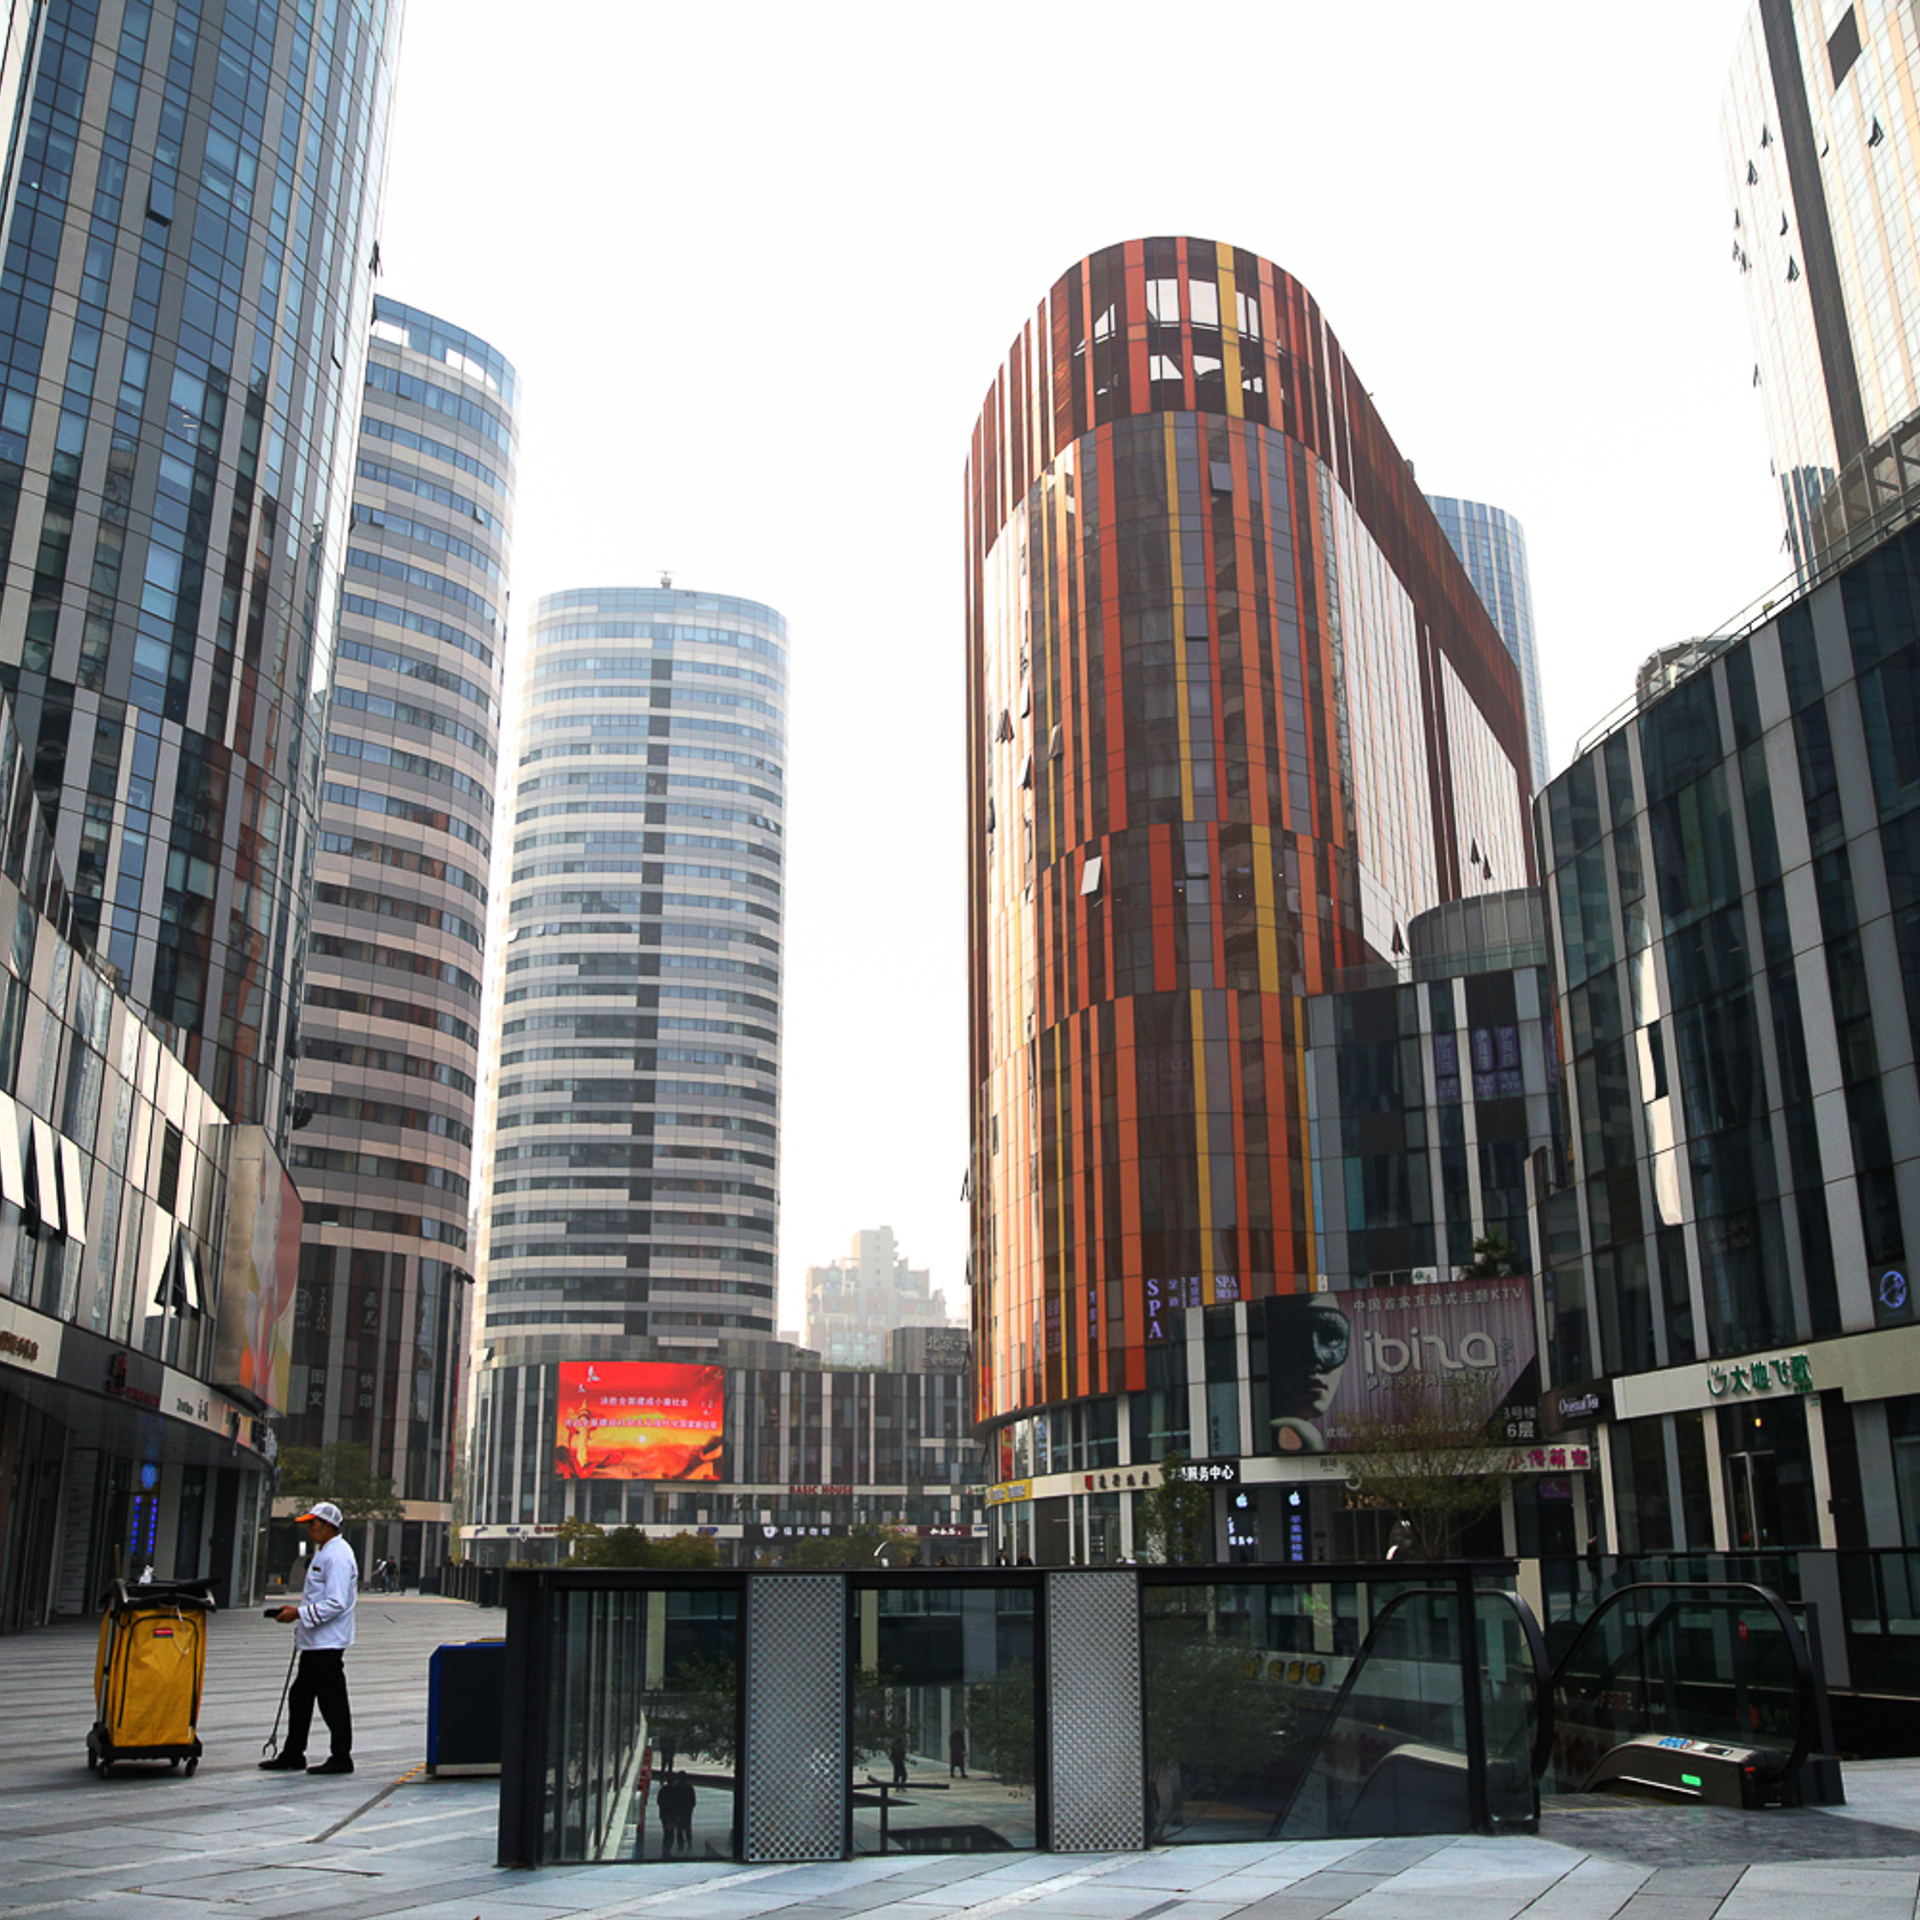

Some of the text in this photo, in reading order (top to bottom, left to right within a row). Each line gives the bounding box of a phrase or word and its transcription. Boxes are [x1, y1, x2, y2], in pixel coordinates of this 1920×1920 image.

[1215, 1275, 1238, 1288] SPA
[1147, 1278, 1163, 1339] SPA
[1364, 1325, 1498, 1373] ibiza
[1730, 1353, 1812, 1393] 大地飞歌
[1506, 1421, 1535, 1438] 6层
[789, 1484, 854, 1495] BASIC HOUSE
